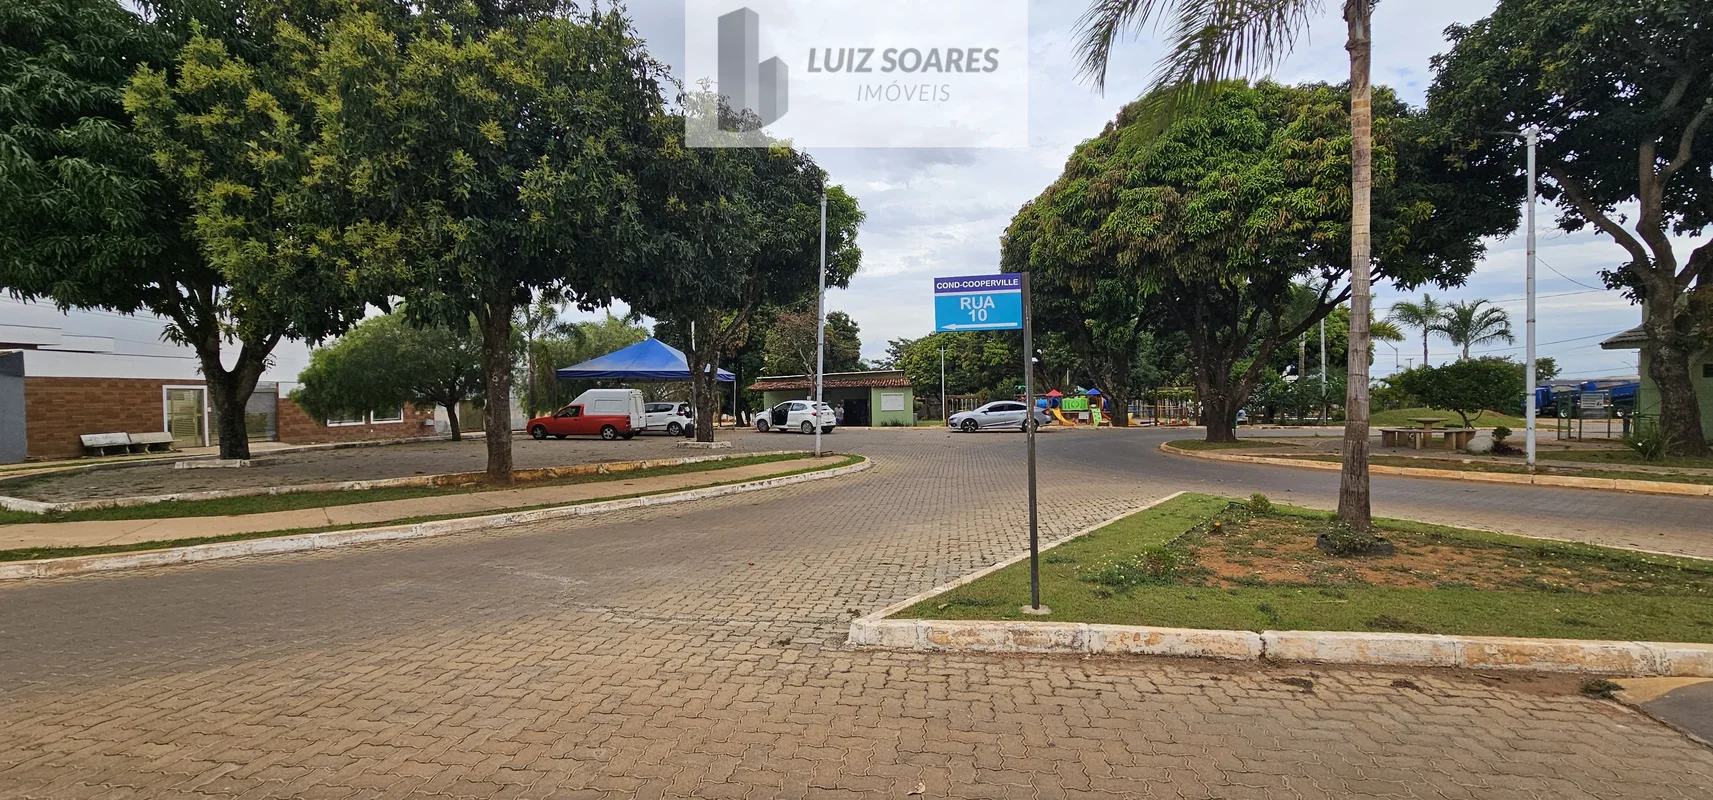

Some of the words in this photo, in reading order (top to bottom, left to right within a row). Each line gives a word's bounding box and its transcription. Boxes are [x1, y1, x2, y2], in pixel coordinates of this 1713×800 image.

[936, 278, 1019, 289] COND-COOPERVILLE
[960, 295, 995, 310] RUA
[968, 309, 988, 322] 10
